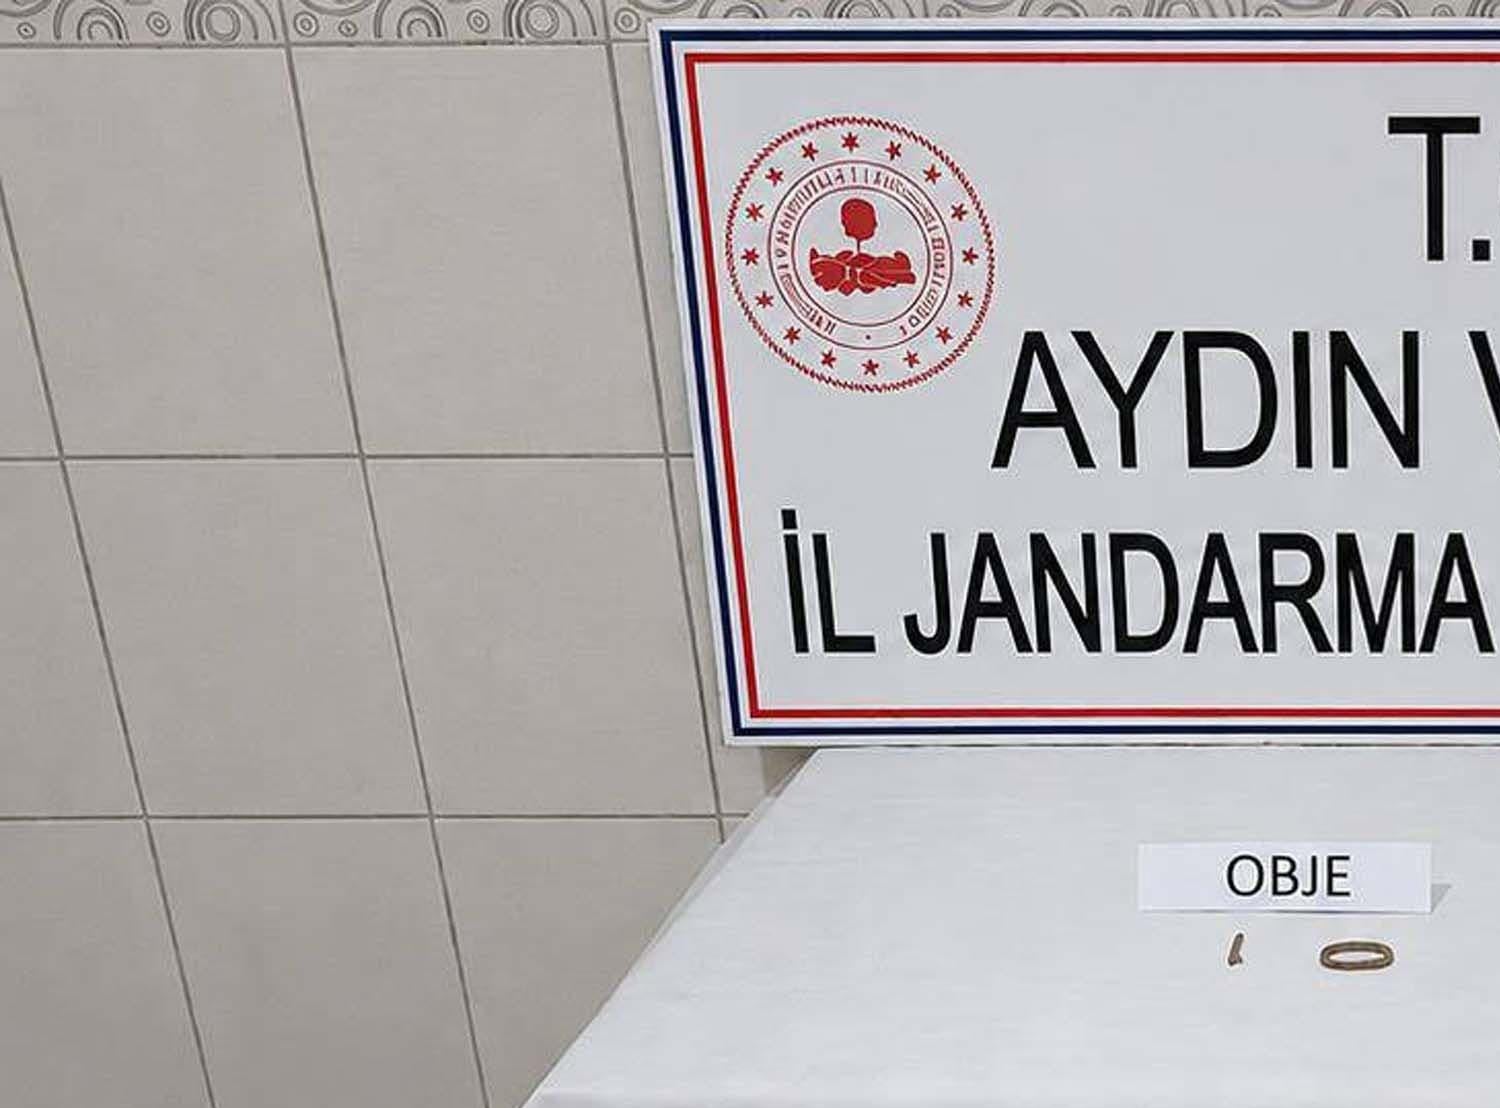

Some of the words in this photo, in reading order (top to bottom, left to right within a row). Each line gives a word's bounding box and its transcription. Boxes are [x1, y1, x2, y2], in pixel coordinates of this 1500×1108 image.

[990, 330, 1420, 469] AYDIN
[780, 508, 877, 654] İL
[903, 532, 1495, 655] JANDARMA
[1226, 854, 1351, 897] OBJE
